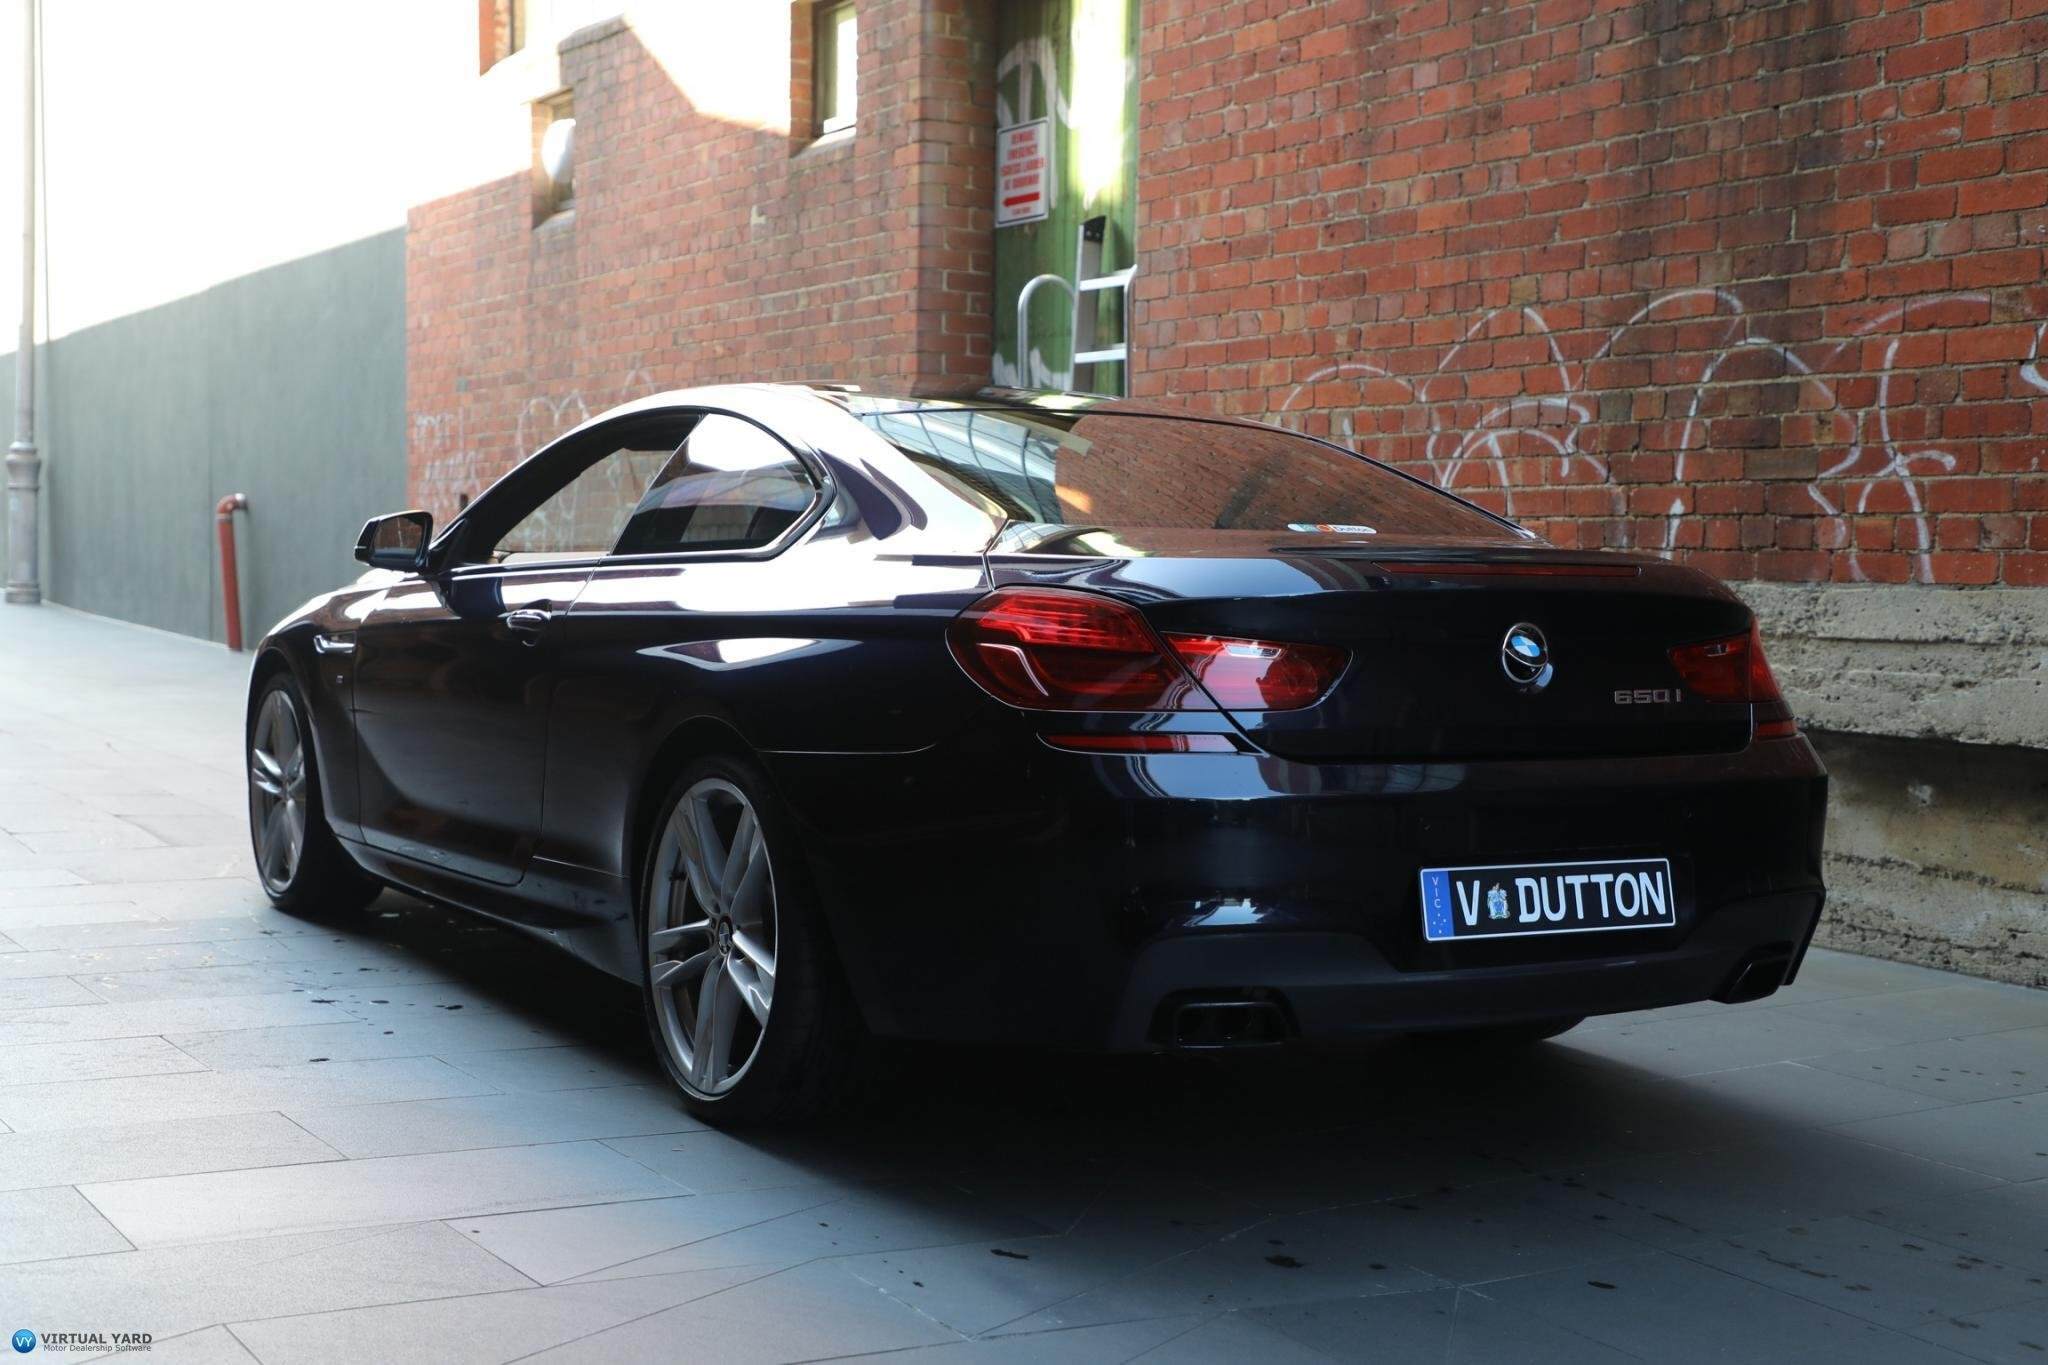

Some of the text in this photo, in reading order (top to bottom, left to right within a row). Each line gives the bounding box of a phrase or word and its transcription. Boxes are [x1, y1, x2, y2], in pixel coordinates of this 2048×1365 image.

[1431, 876, 1442, 909] VIC
[1456, 871, 1666, 926] V DUTTON
